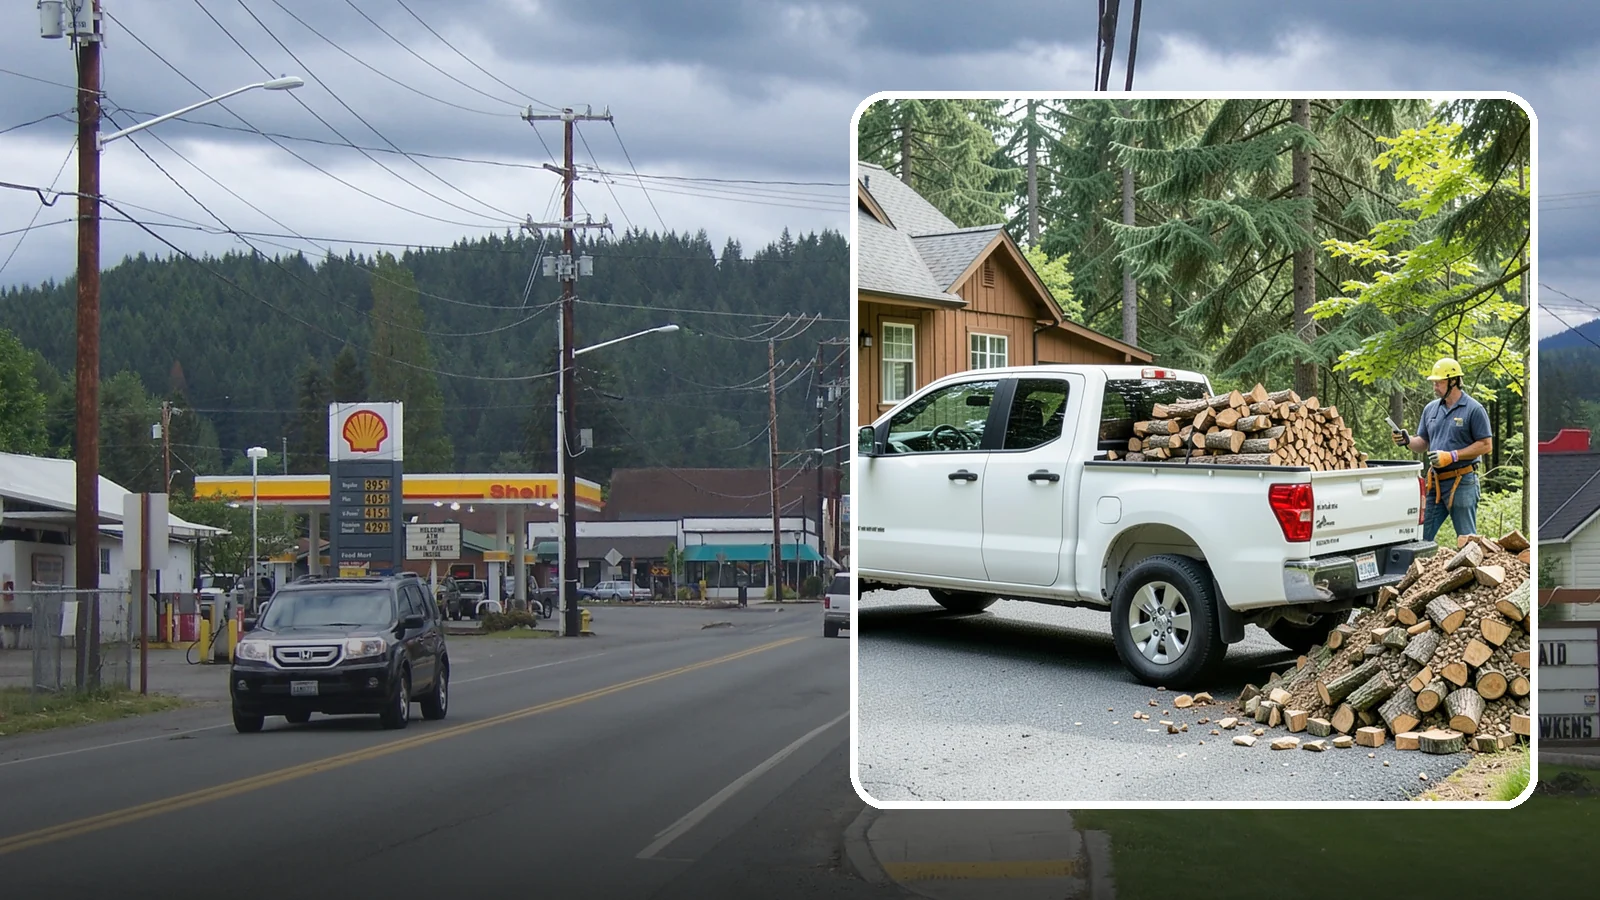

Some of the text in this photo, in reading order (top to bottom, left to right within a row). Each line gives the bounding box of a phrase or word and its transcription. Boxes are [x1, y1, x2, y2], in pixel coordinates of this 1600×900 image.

[366, 480, 384, 490] 395
[490, 484, 547, 499] Shell
[365, 494, 384, 504] 405
[365, 508, 384, 518] 415
[365, 522, 384, 532] 429
[1538, 642, 1567, 666] AID
